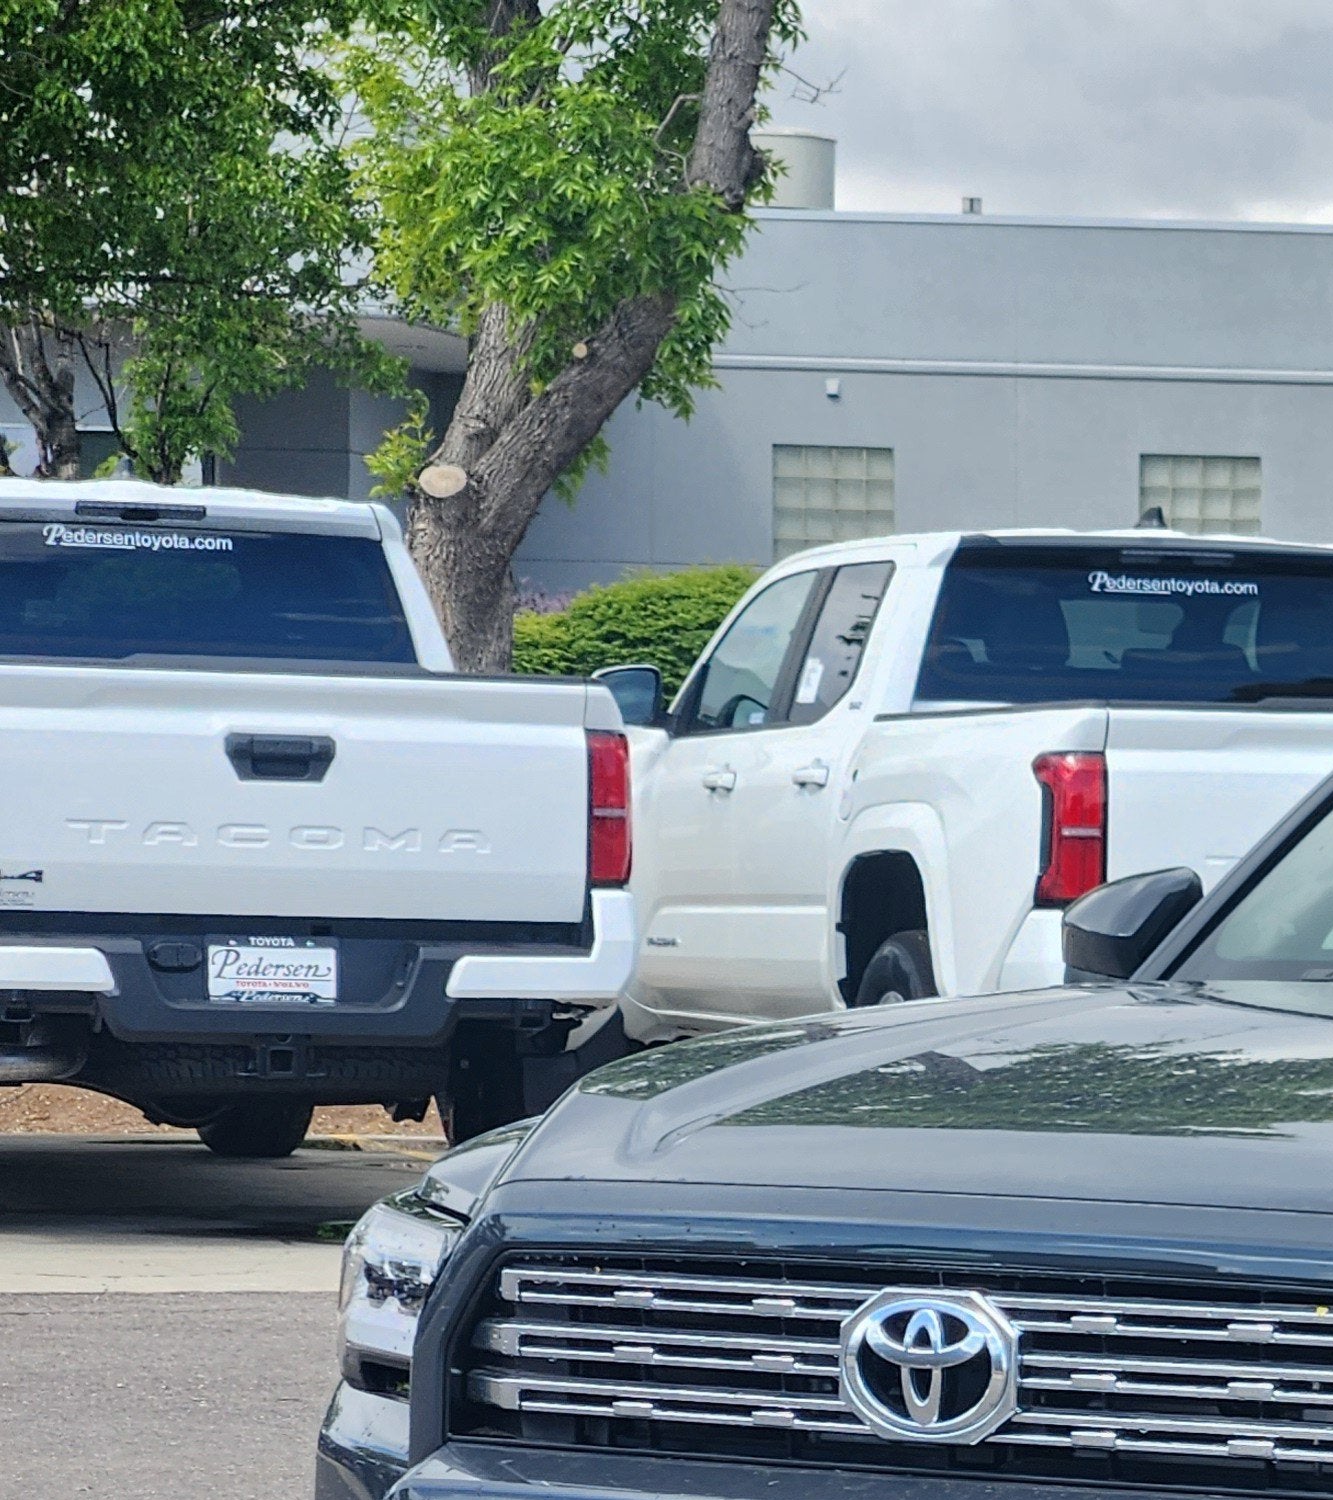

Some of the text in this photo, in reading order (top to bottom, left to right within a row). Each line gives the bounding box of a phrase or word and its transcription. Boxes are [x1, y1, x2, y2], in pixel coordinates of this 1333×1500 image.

[43, 524, 233, 551] Pedersentoyota.com
[1088, 570, 1258, 596] Pedersentoyota.com
[66, 818, 491, 854] TACOMA
[248, 936, 296, 947] TOYOTA
[211, 948, 332, 979] Pedersen
[236, 980, 310, 989] TOYOTA VOLVO
